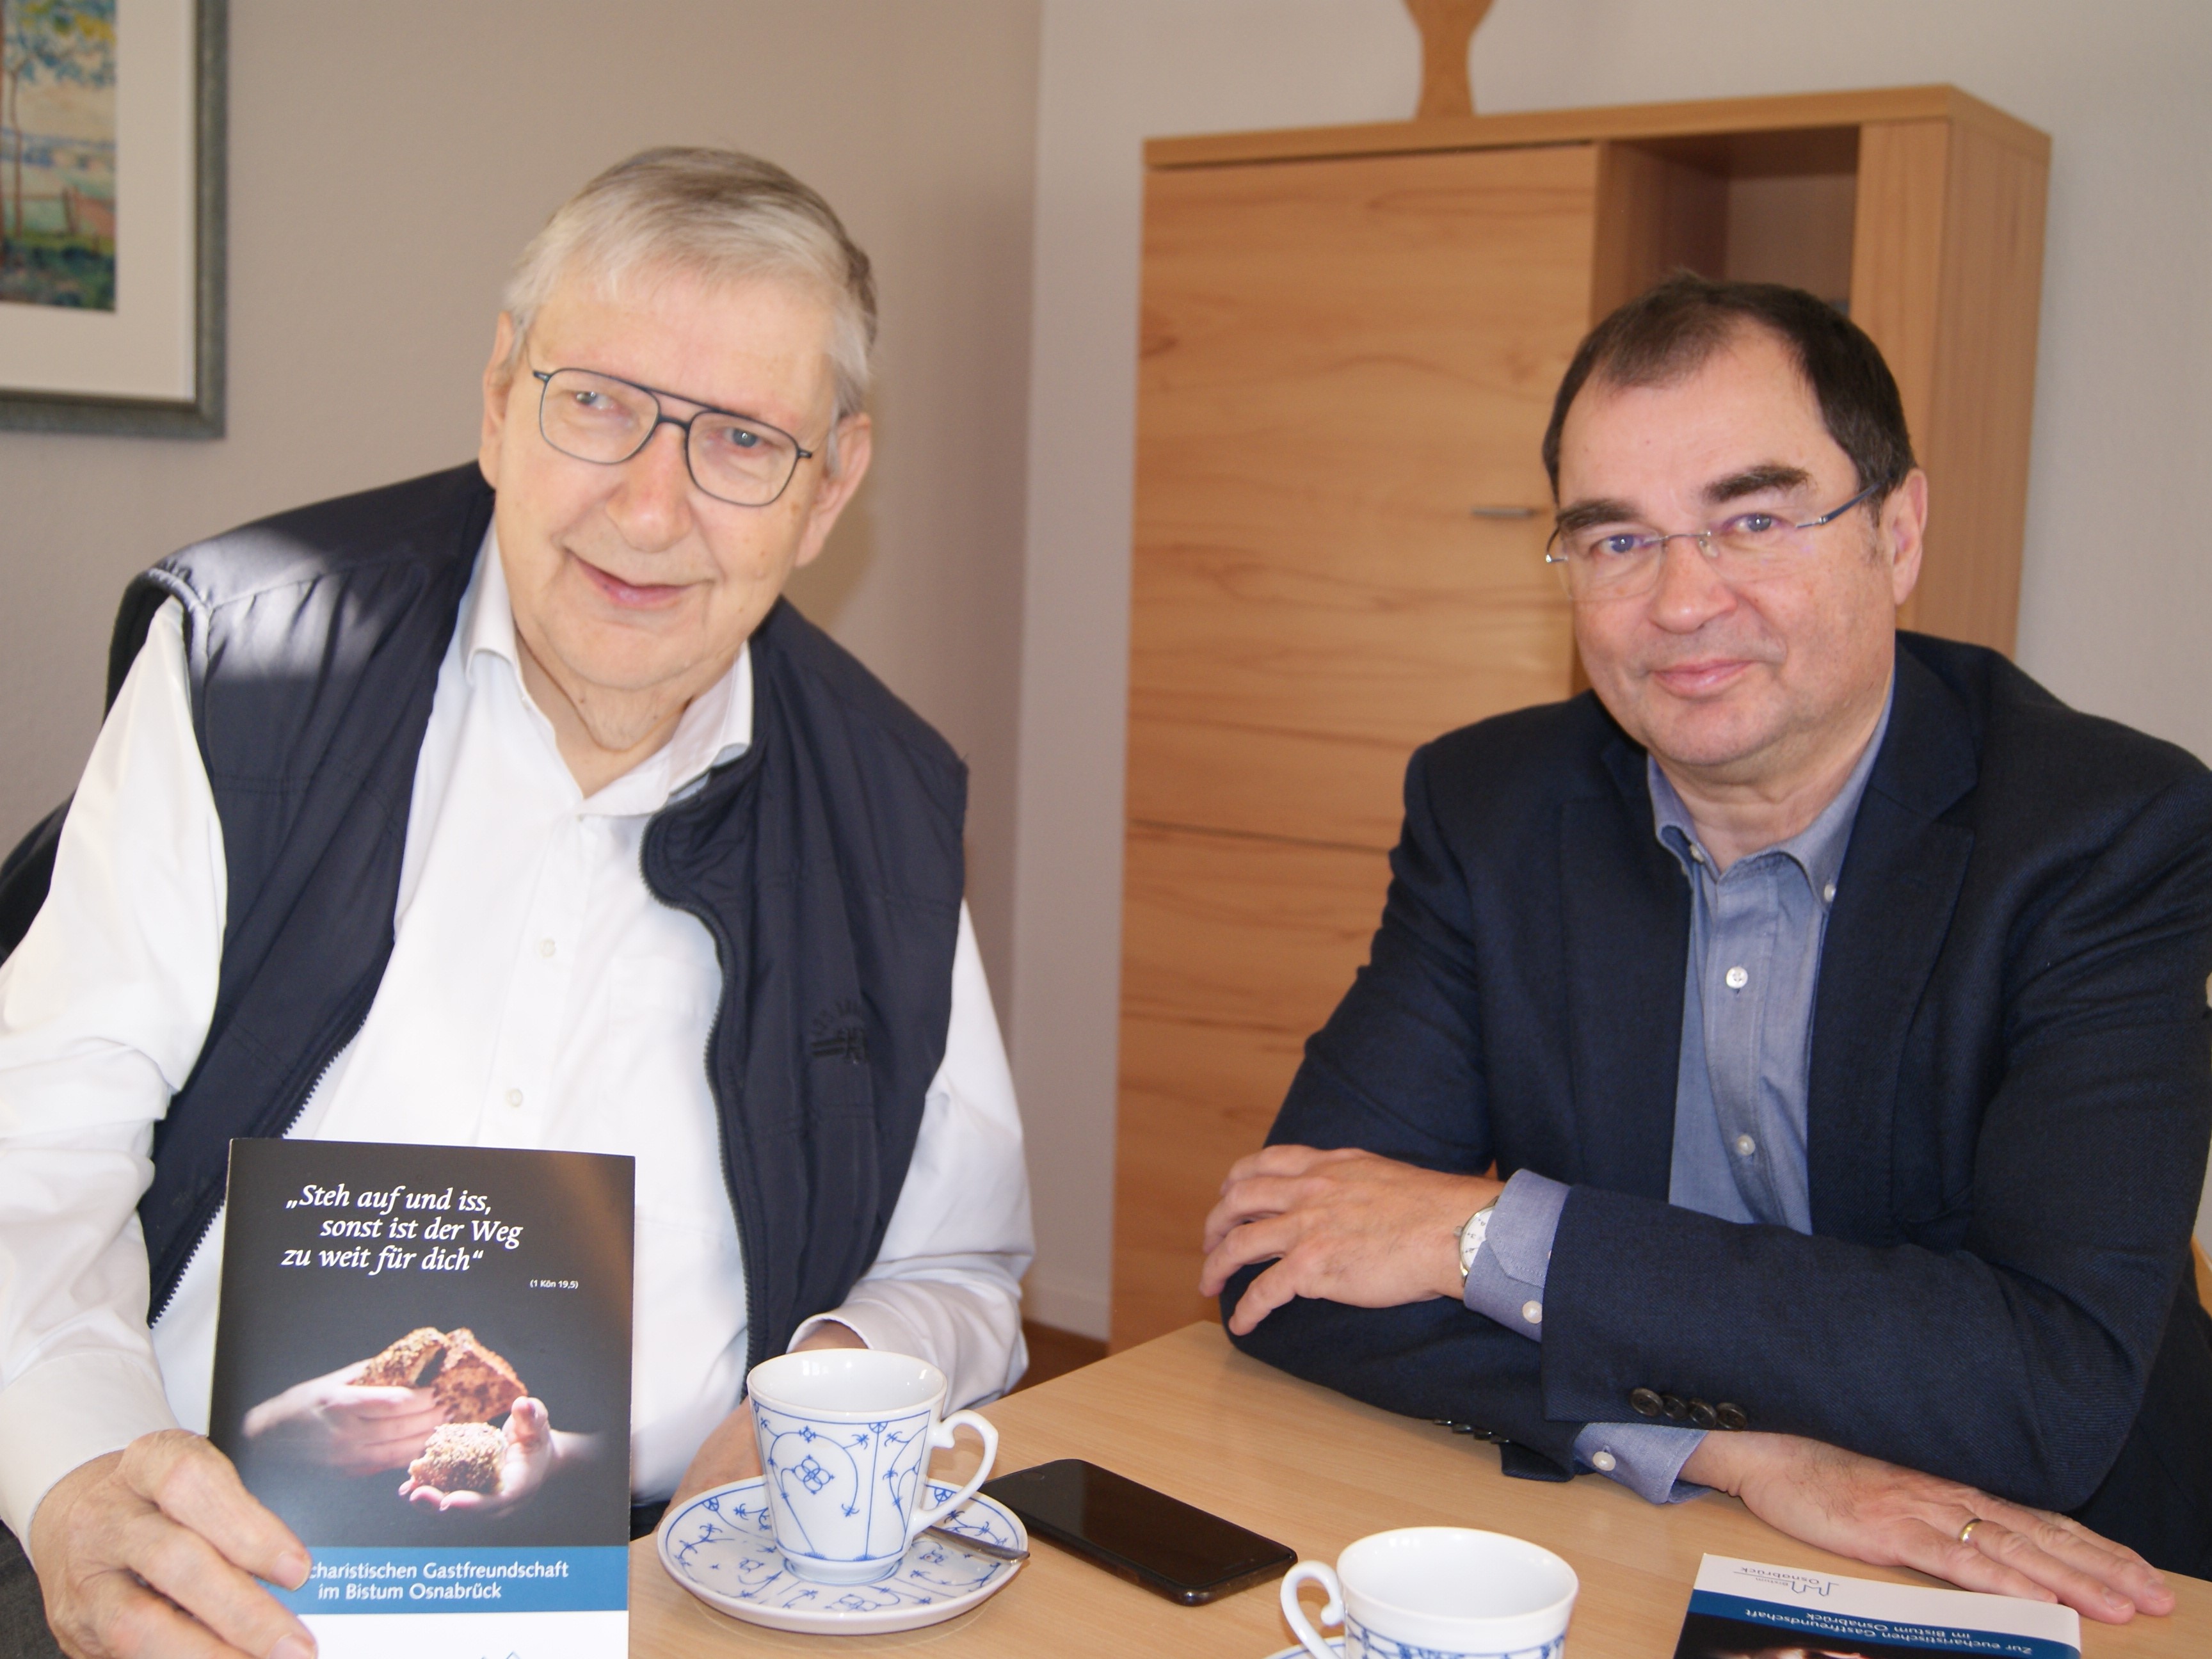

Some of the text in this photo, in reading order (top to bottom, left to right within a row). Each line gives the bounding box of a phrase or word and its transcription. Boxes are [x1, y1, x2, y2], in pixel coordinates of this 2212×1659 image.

[357, 1186, 405, 1215] auf
[405, 1188, 453, 1211] und
[458, 1190, 492, 1215] iss,
[321, 1217, 522, 1249] sonst ist der Weg
[281, 1249, 310, 1266] zu
[319, 1247, 371, 1268] weit
[369, 1246, 415, 1276] für
[529, 1279, 579, 1289] (1 Kön 19,5)
[310, 1560, 569, 1579] charistischen Gastfreundschaft
[1741, 1566, 1820, 1585] Osnabrück
[318, 1582, 502, 1599] im Bistum Osnabrück
[1806, 1612, 1888, 1631] Osnabrück
[1745, 1608, 2033, 1655] Zur eucharistischen Gastfreundschaft
[1894, 1625, 1946, 1638] Bistum
